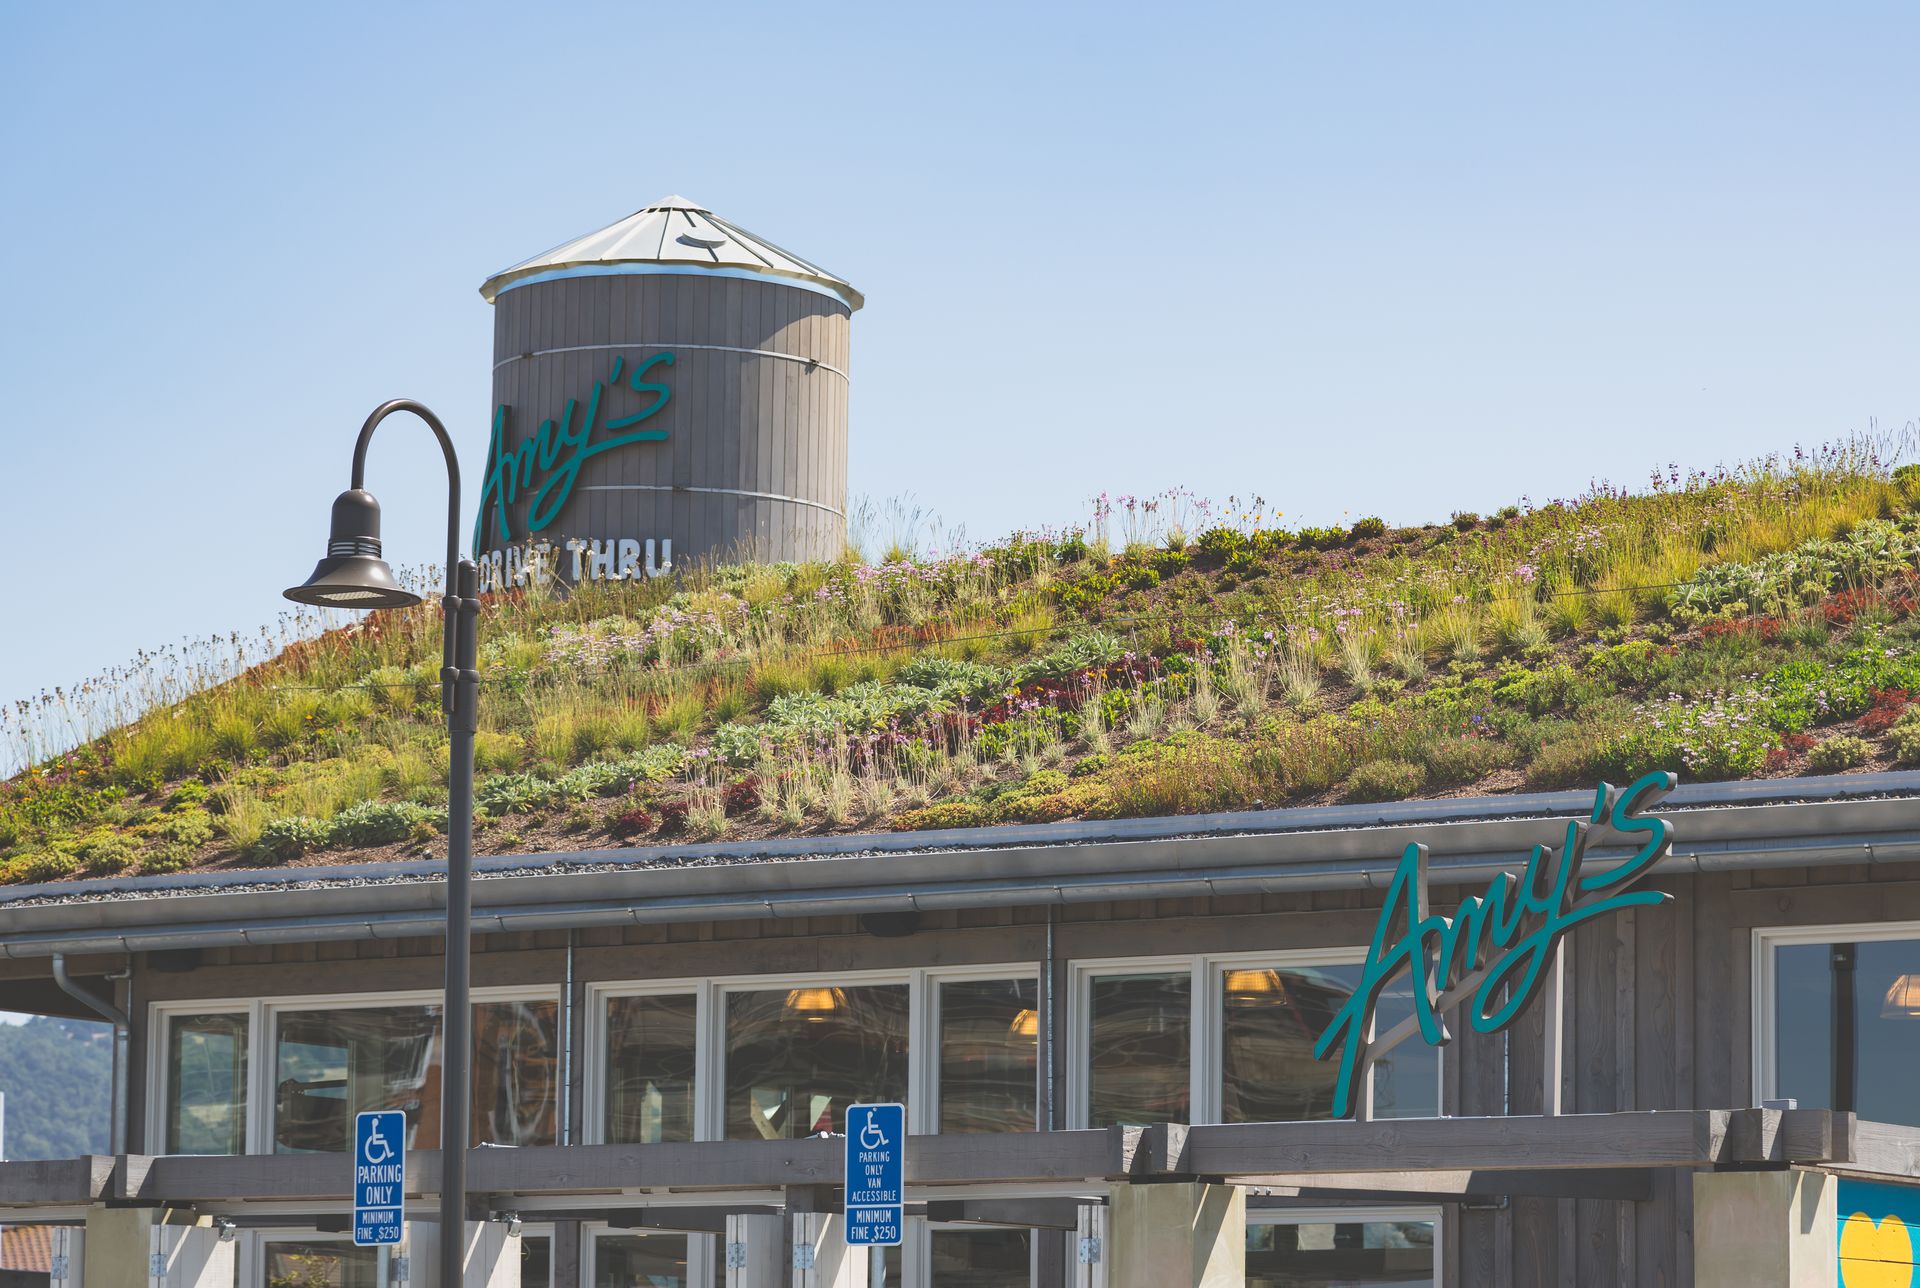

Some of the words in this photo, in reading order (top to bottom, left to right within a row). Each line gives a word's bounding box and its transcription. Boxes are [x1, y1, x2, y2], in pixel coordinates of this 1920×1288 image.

[479, 543, 552, 594] DRIVE
[566, 538, 672, 581] THRU
[859, 1151, 890, 1163] PARKING
[358, 1164, 402, 1184] PARKING
[865, 1164, 884, 1176] ONLY
[867, 1177, 882, 1188] VAN
[366, 1186, 393, 1205] ONLY
[852, 1190, 897, 1202] ACCESSIBLE
[362, 1211, 394, 1224] MINIMUM
[856, 1210, 892, 1223] MINIMUM
[357, 1227, 373, 1240] FINE
[378, 1226, 399, 1240] $250
[851, 1226, 870, 1240] FINE
[873, 1225, 896, 1240] $250
